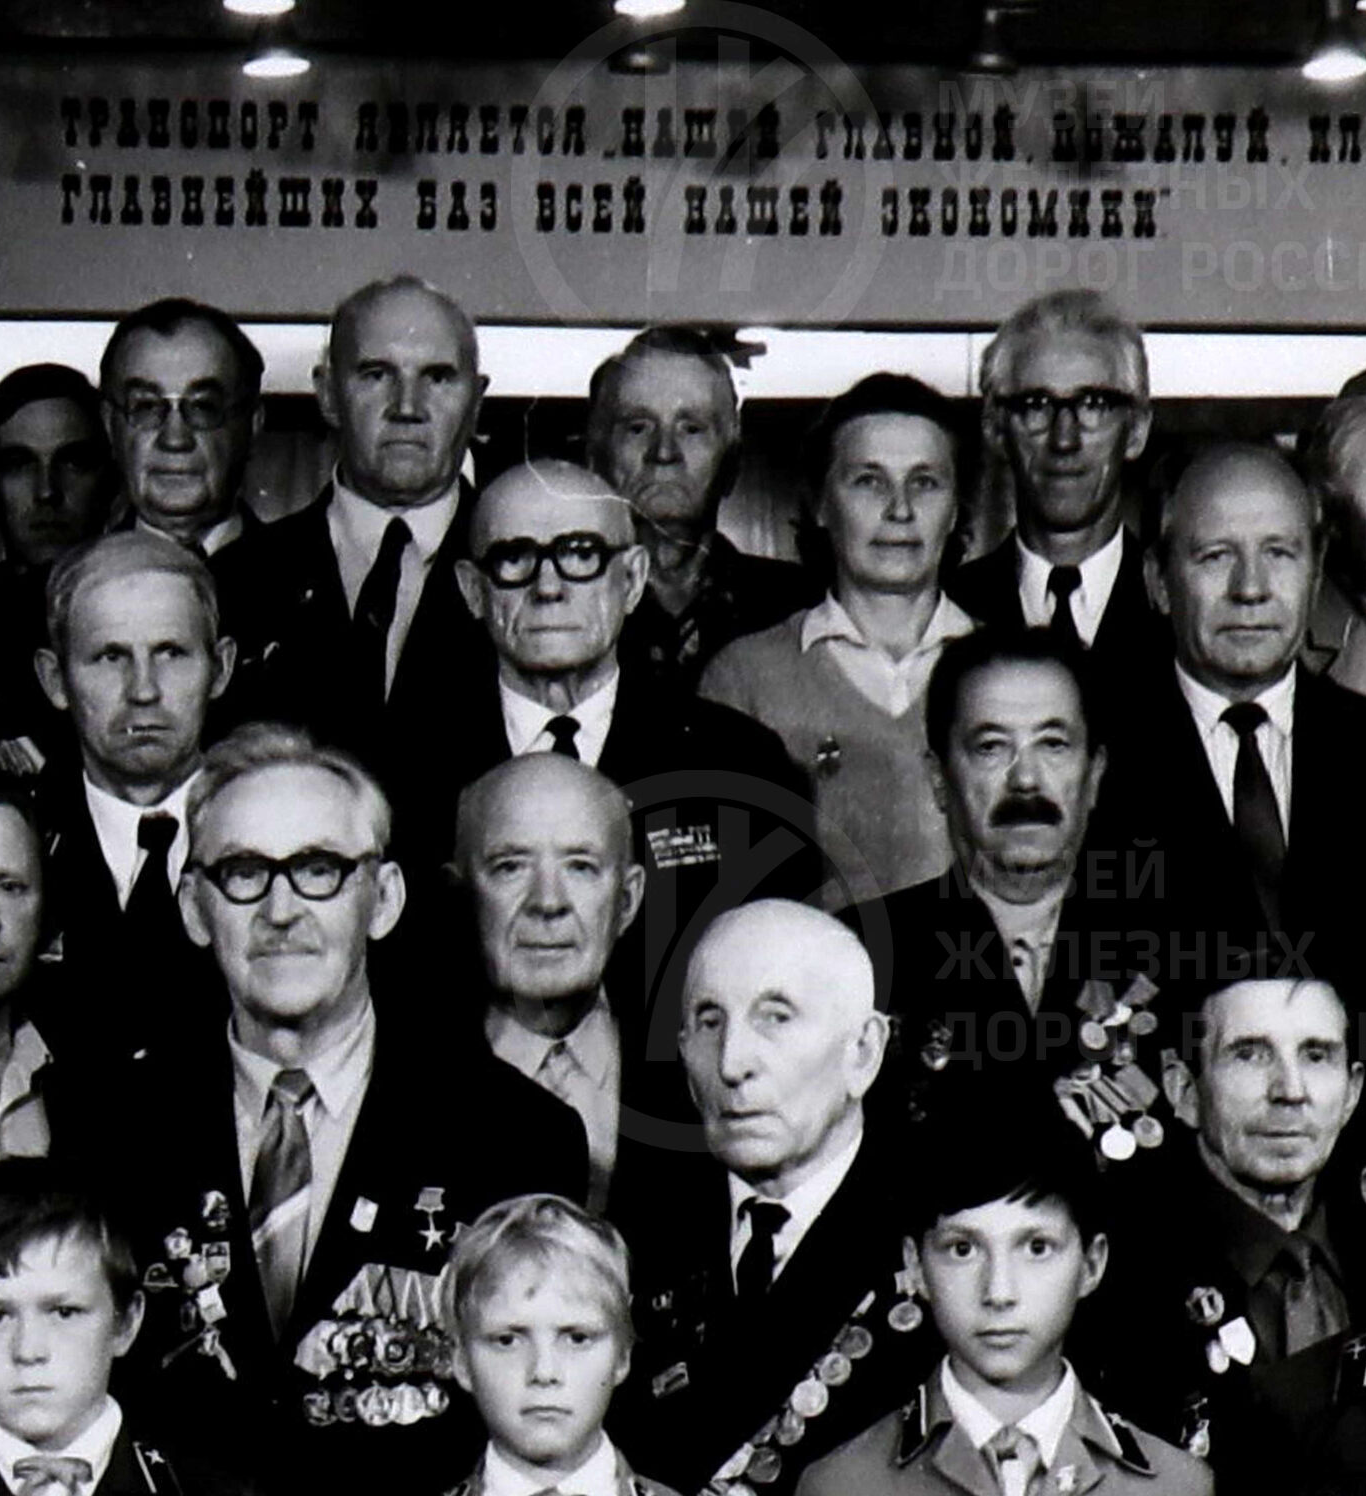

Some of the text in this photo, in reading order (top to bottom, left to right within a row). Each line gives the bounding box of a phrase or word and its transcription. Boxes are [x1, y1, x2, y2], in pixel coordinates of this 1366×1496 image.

[61, 97, 318, 150] ТРАНСПОРТ
[62, 168, 378, 227] ГЛАВНЕЙШИХ
[417, 179, 496, 230] БАЗ
[536, 176, 645, 233] ВСЕЙ
[685, 180, 842, 235] НАШЕЙ
